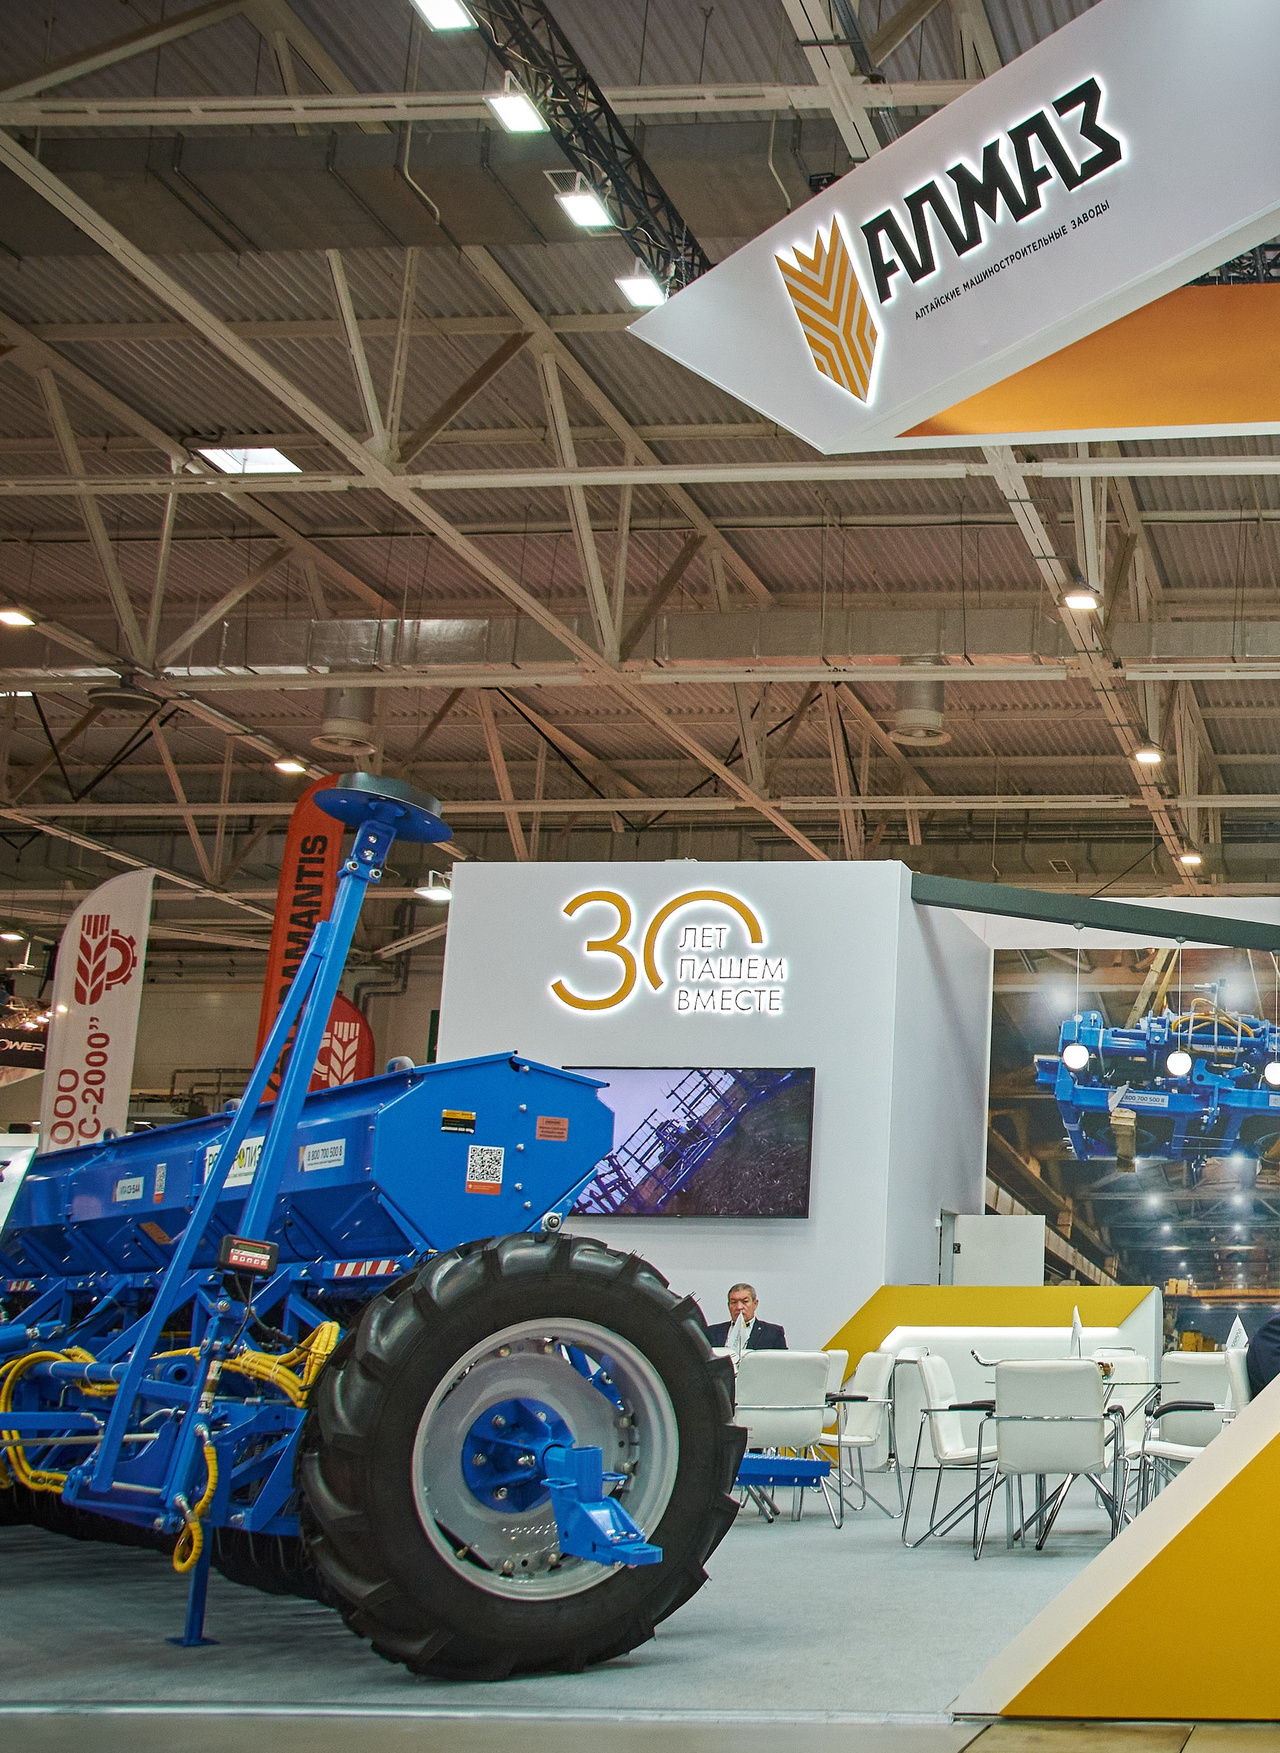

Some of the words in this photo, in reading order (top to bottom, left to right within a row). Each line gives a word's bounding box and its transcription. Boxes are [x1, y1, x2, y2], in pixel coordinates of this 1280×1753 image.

[860, 77, 1122, 304] АЛМАЗ
[914, 287, 962, 320] АЛТАЙСКИЕ
[963, 225, 1068, 292] МАШИНОСТРОИТЕЛЬНЫЕ
[1070, 200, 1110, 230] ЗАВОДЫ
[551, 890, 763, 1010] 30
[679, 927, 727, 948] ЛЕТ
[679, 958, 784, 979] ПАШЕМ
[677, 989, 781, 1011] ВМЕСТЕ
